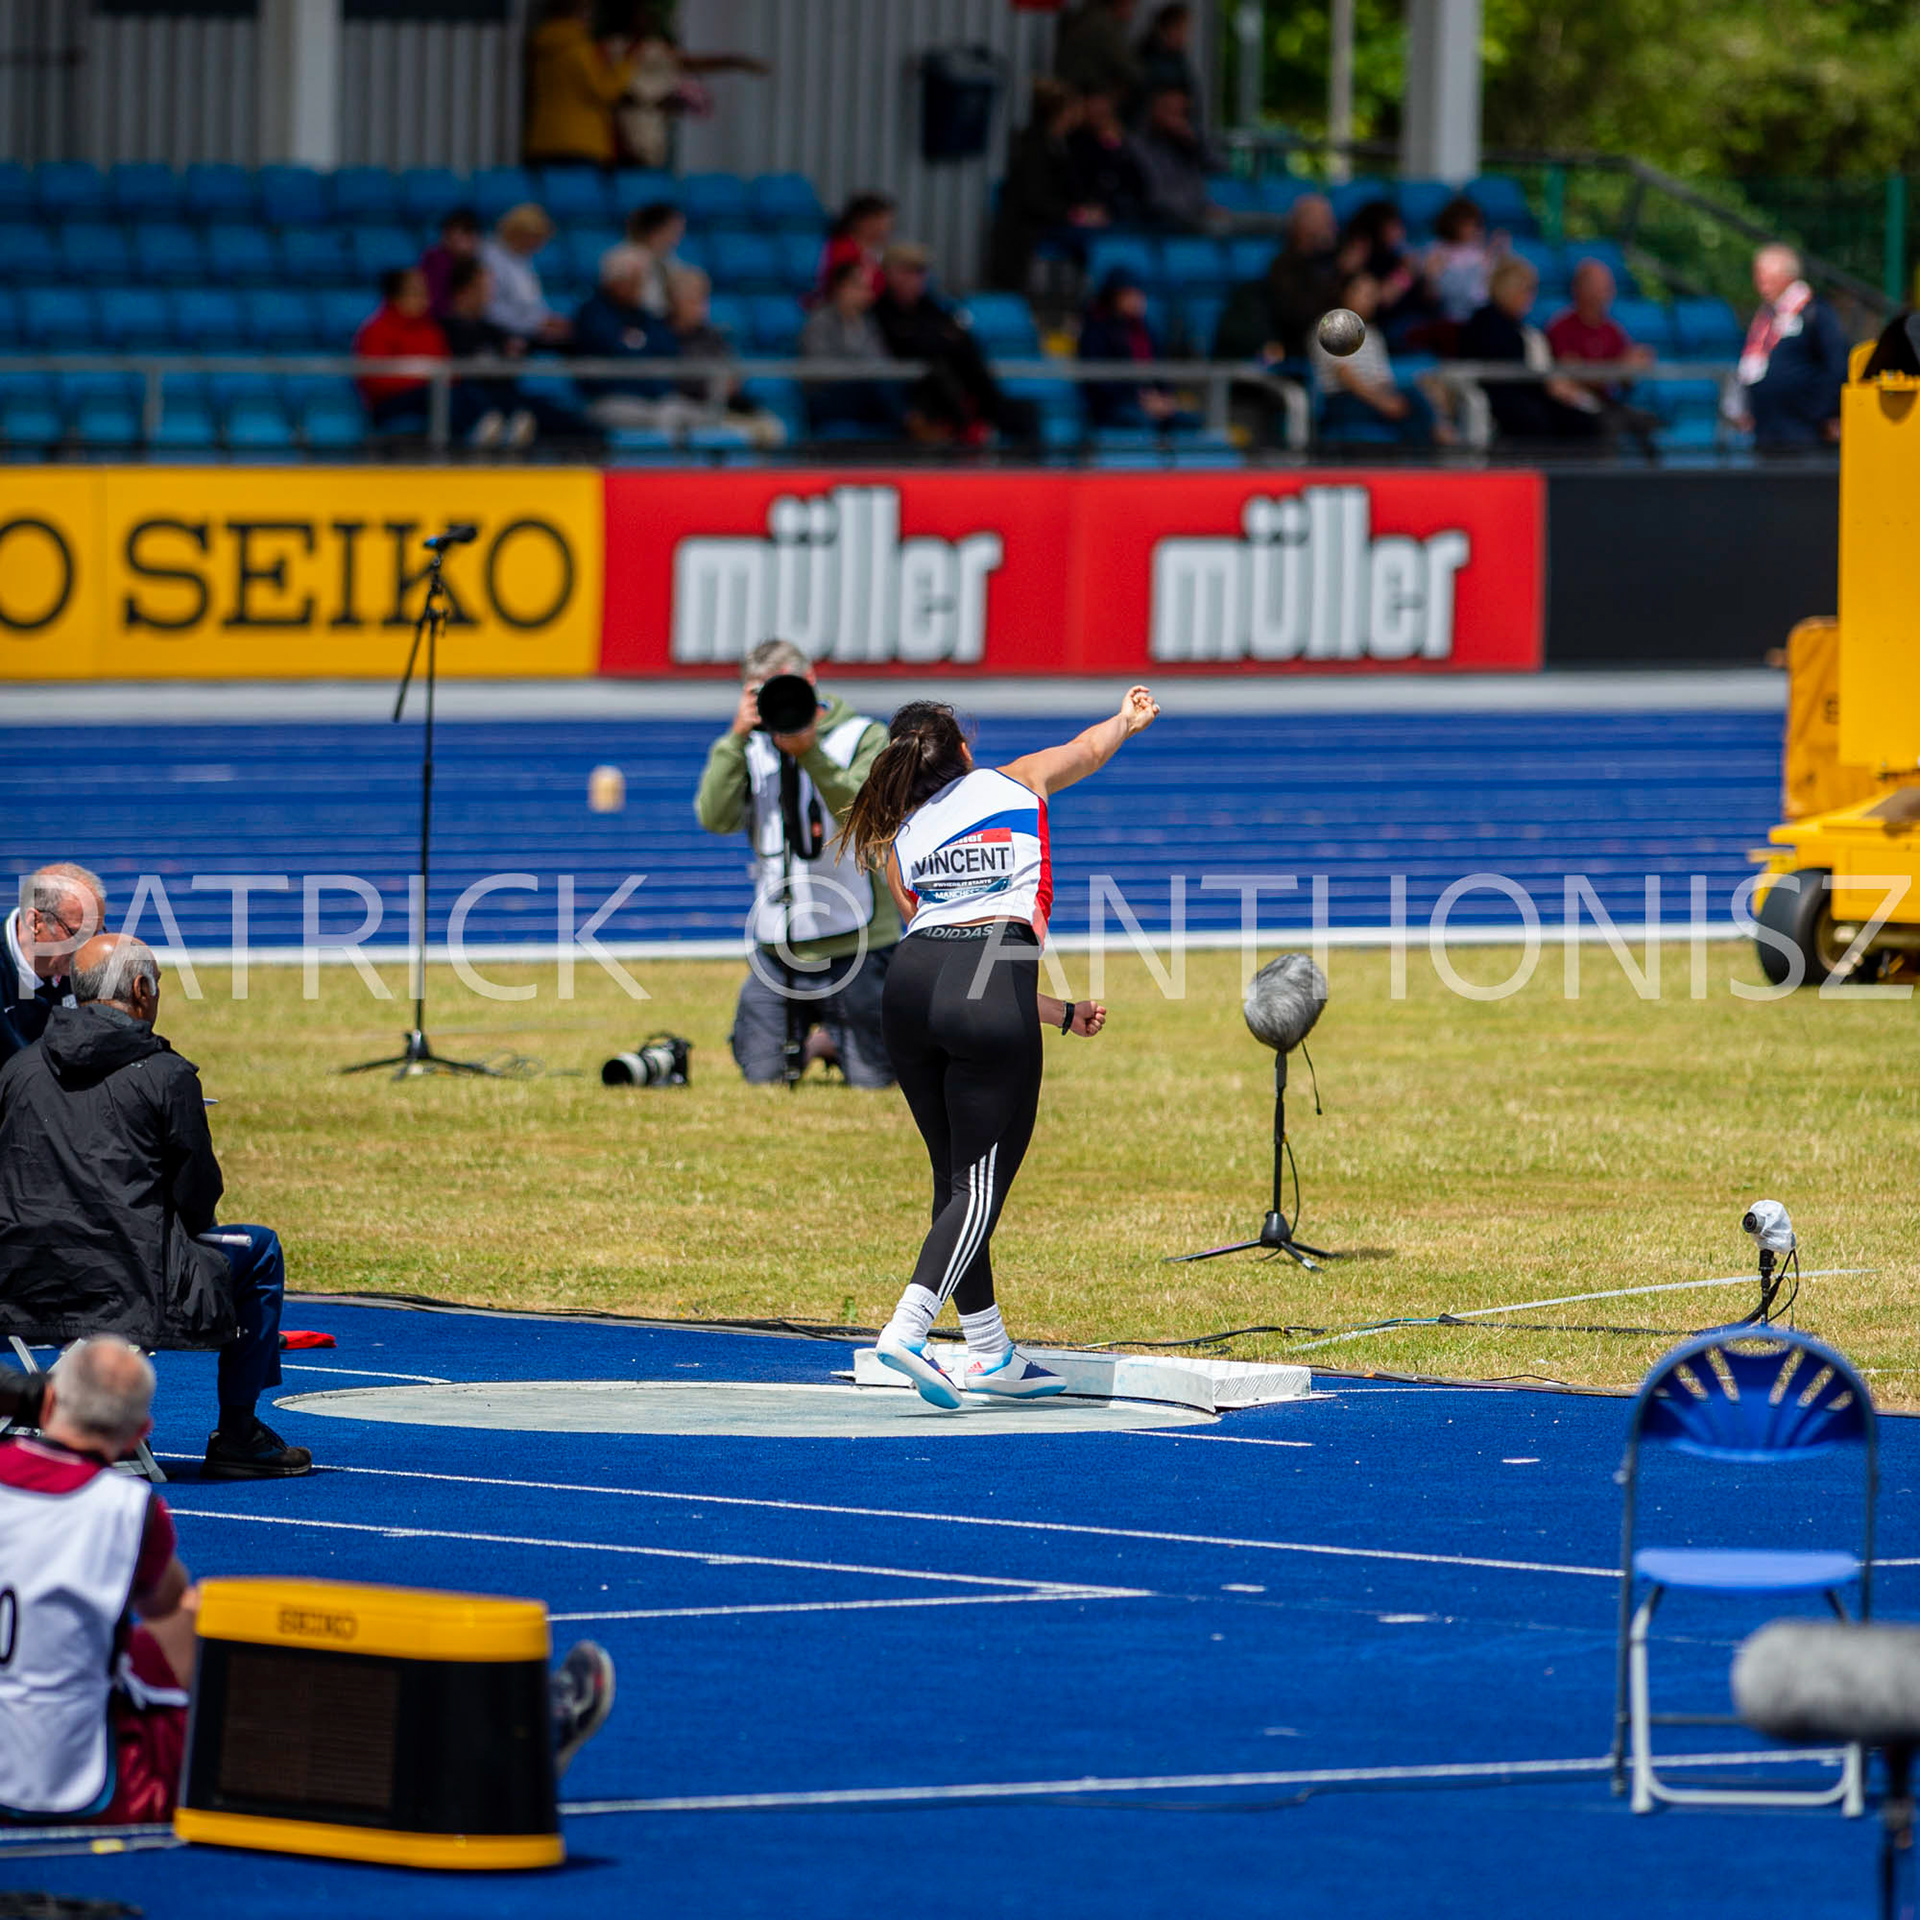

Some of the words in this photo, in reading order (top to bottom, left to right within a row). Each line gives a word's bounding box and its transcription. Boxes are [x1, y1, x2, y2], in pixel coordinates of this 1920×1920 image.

[121, 517, 575, 633] SEIKO
[673, 484, 1002, 664] müller
[1150, 484, 1470, 661] müller
[914, 847, 1010, 876] VINCENT
